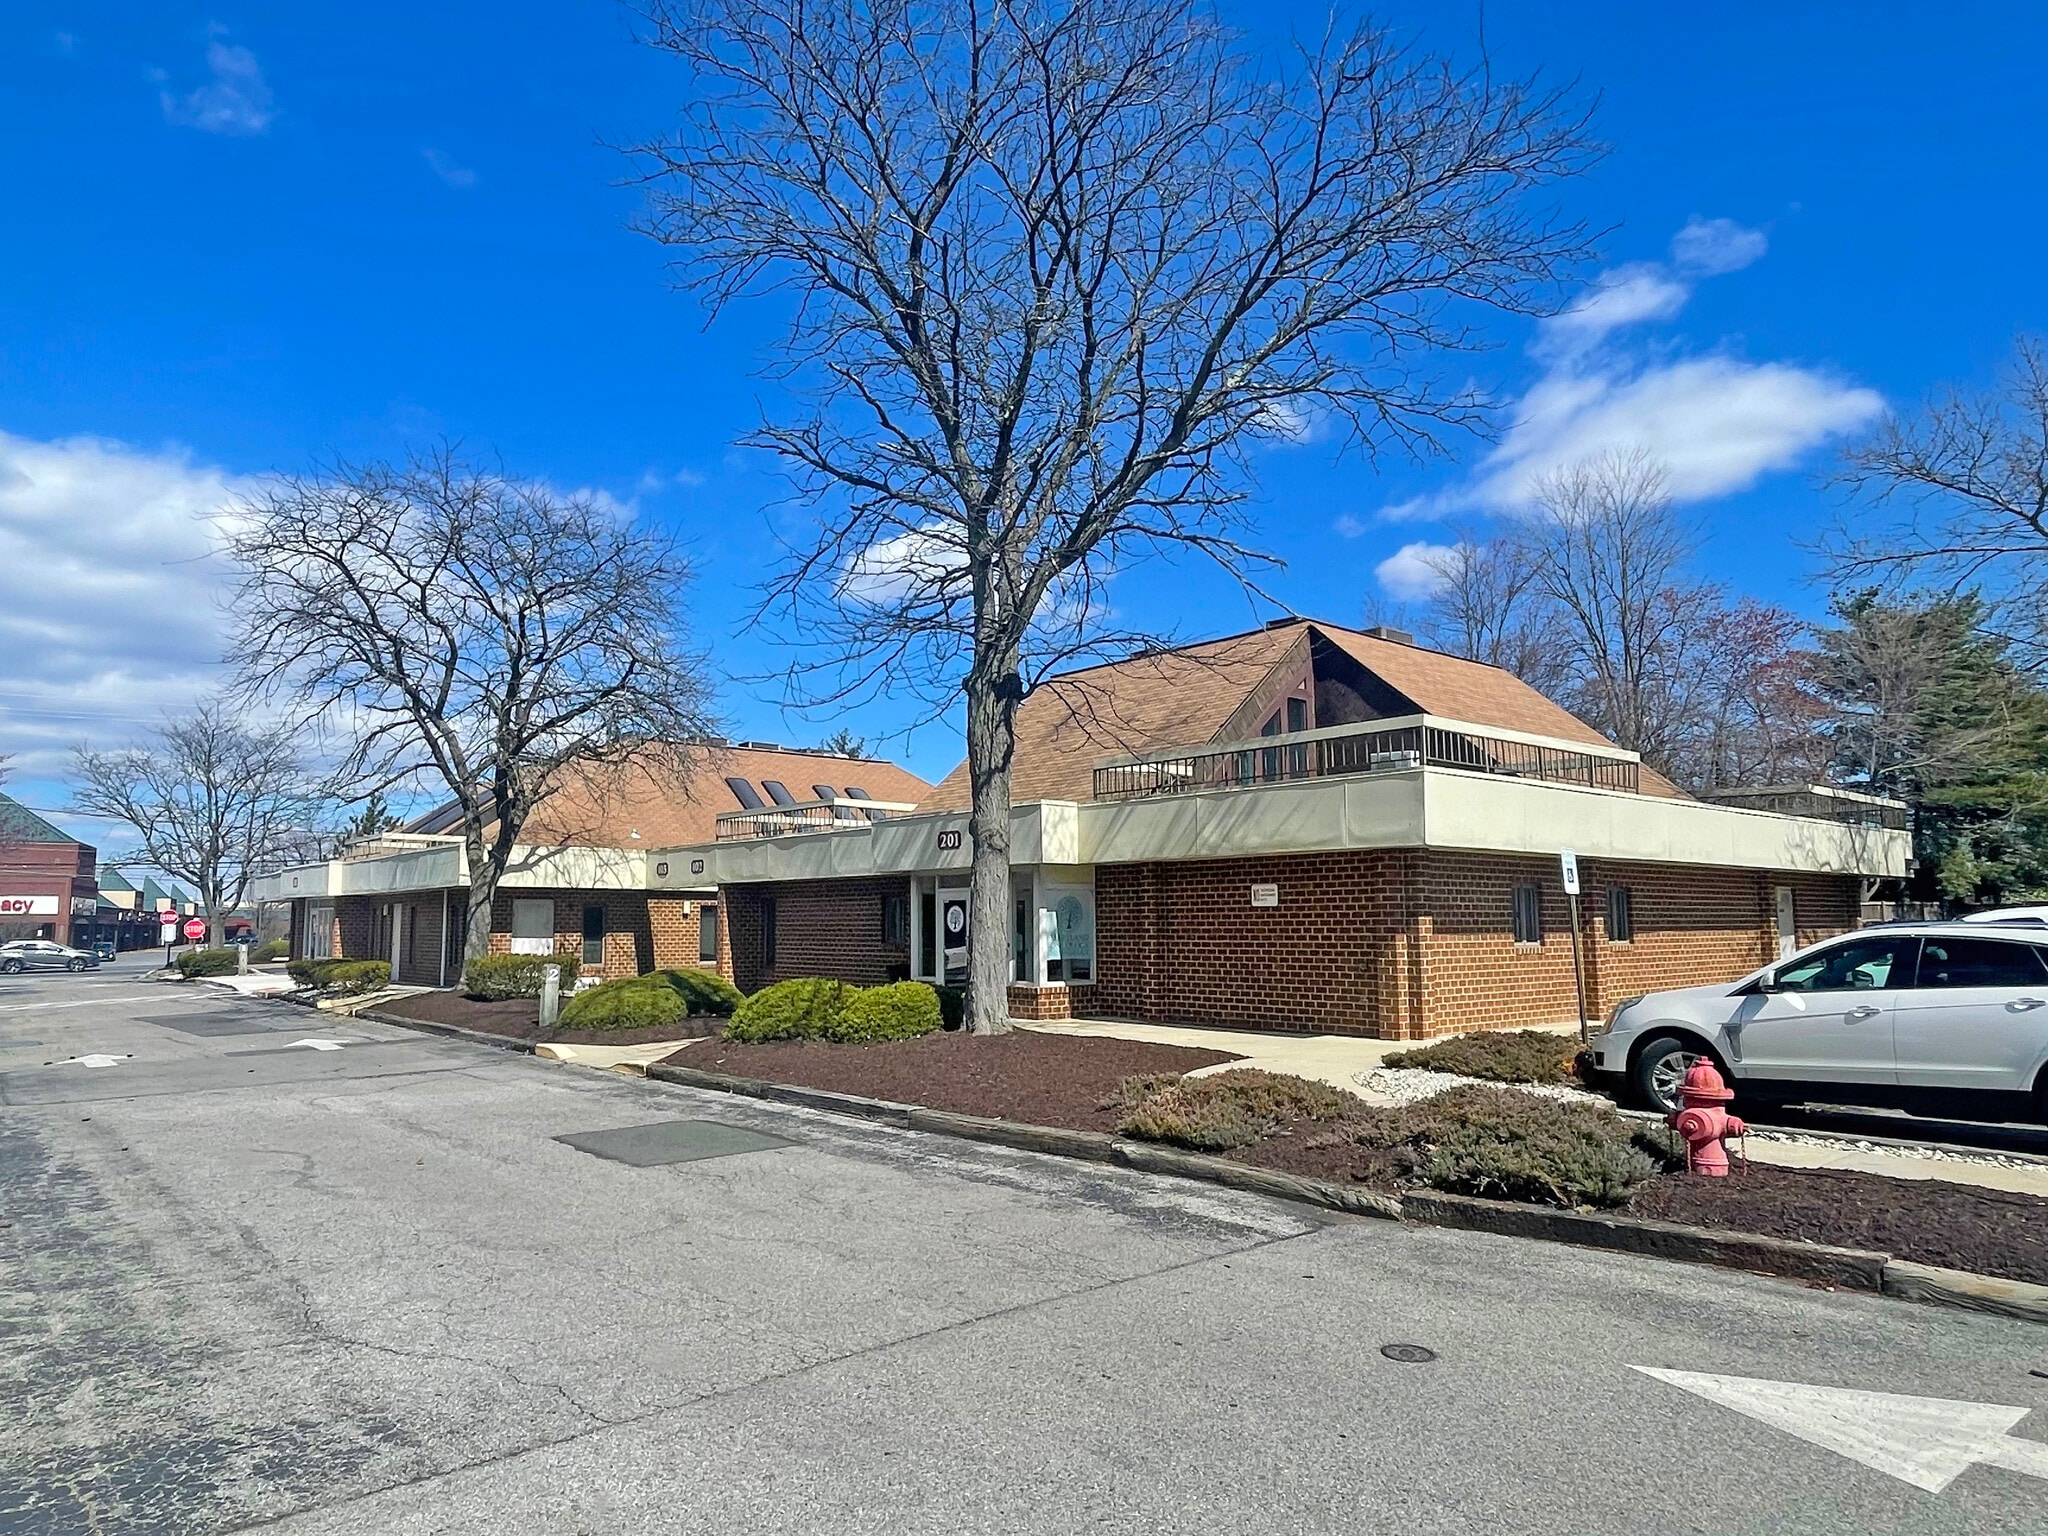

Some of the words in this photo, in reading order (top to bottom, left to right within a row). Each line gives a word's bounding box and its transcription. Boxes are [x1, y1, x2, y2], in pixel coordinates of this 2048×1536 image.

[940, 833, 959, 848] 201
[1, 899, 34, 915] acy
[185, 925, 204, 934] STOP
[548, 968, 559, 981] 2
